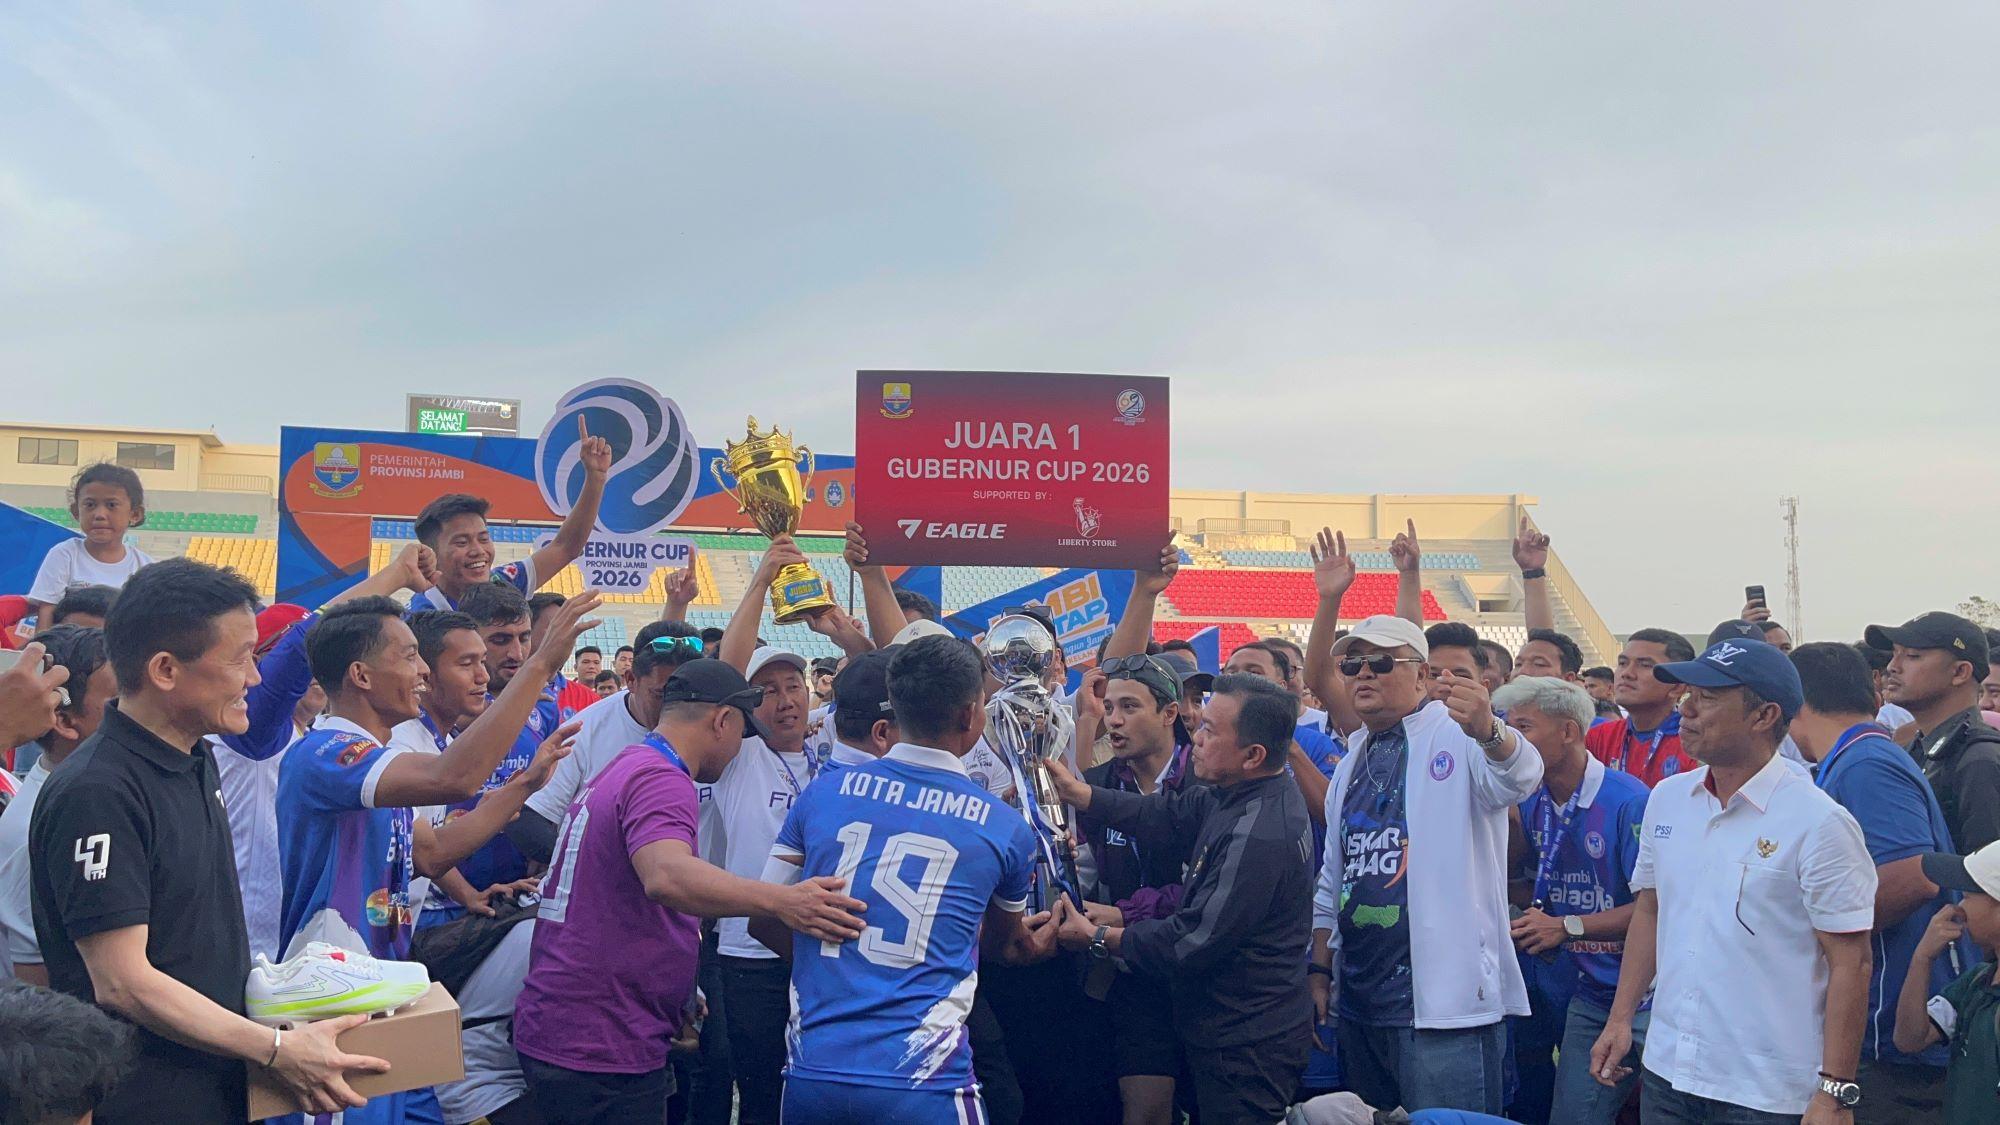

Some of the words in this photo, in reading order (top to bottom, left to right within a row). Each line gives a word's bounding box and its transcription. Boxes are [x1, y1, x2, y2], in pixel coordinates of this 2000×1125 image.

[420, 411, 464, 422] SELAMAT
[420, 420, 462, 431] DATANG!
[944, 421, 1058, 450] JUARA
[1067, 424, 1080, 450] 1
[370, 454, 446, 467] PEMERINTAH
[370, 466, 425, 478] PROVINSI
[428, 468, 464, 480] JAMBI
[887, 457, 1030, 481] GUBERNUR
[1036, 460, 1087, 482] CUP
[1091, 462, 1150, 484] 2026
[973, 490, 1031, 500] SUPPORTED
[925, 522, 1007, 539] EAGLE
[1058, 538, 1091, 547] LIBERTY
[1091, 539, 1117, 547] STORE
[581, 541, 647, 559] ERNUR
[650, 543, 689, 561] CUP
[585, 560, 622, 568] PROVINSI
[623, 561, 648, 569] JAMBI
[591, 569, 642, 587] 2026
[839, 771, 906, 806] KOTA
[906, 786, 991, 826] JAMBI
[1655, 824, 1673, 835] PSSI
[820, 821, 960, 970] 19
